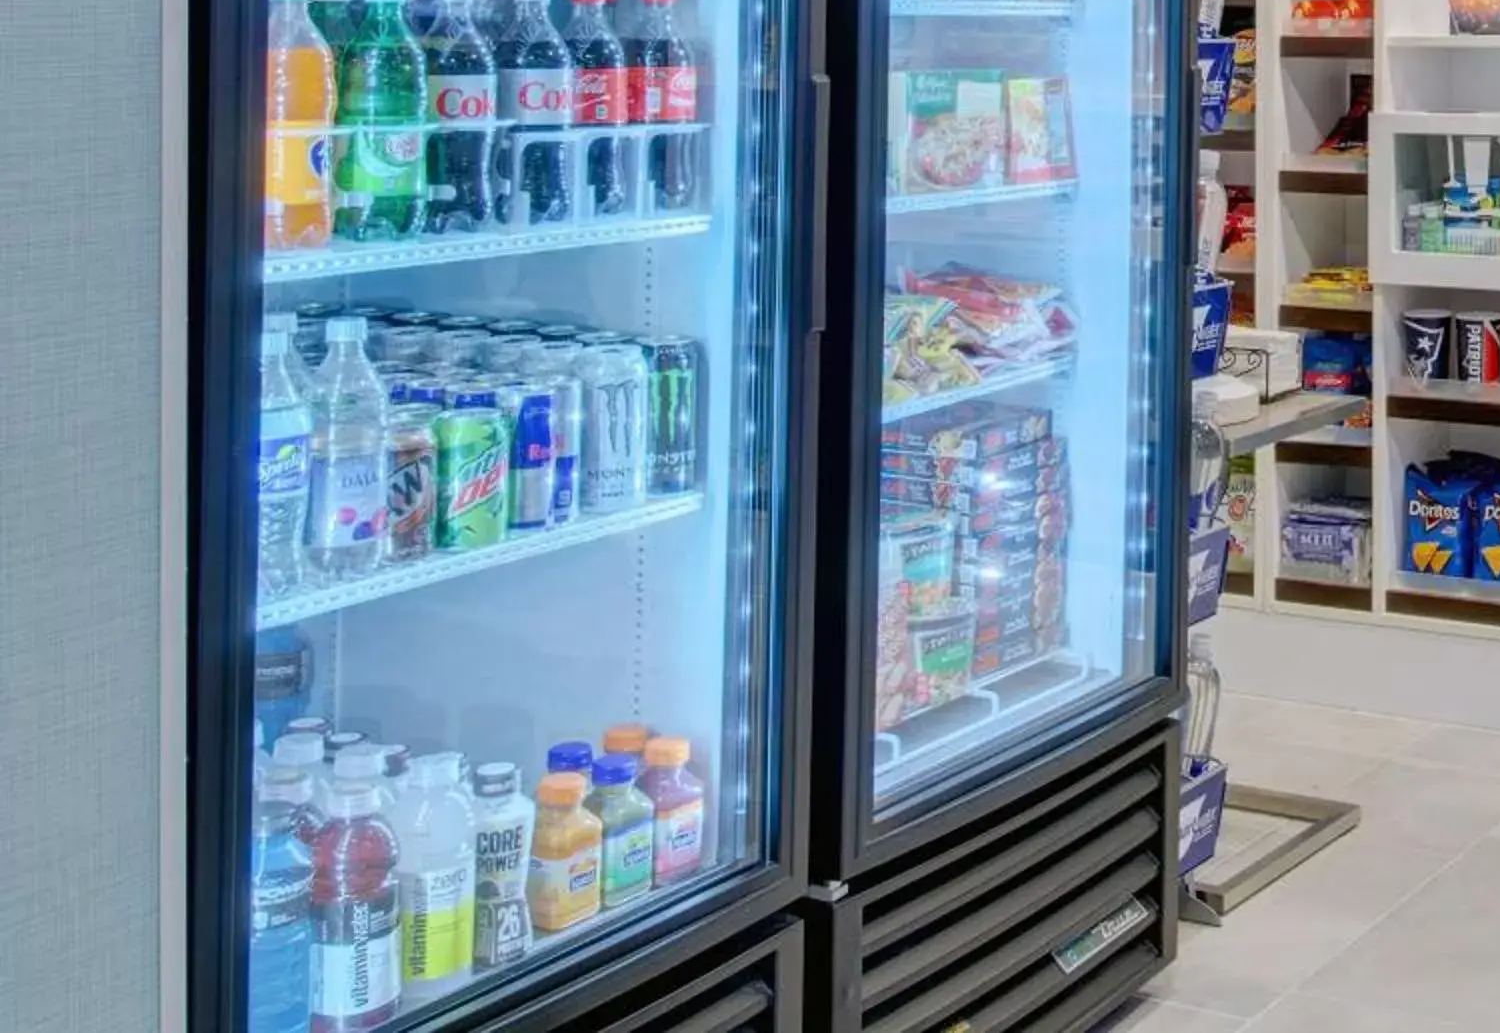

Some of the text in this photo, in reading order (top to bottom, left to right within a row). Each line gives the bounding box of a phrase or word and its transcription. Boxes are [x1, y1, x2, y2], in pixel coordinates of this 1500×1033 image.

[1409, 500, 1460, 520] Doritos
[476, 825, 523, 855] CORE
[476, 853, 521, 873] POWER
[497, 904, 521, 938] 26
